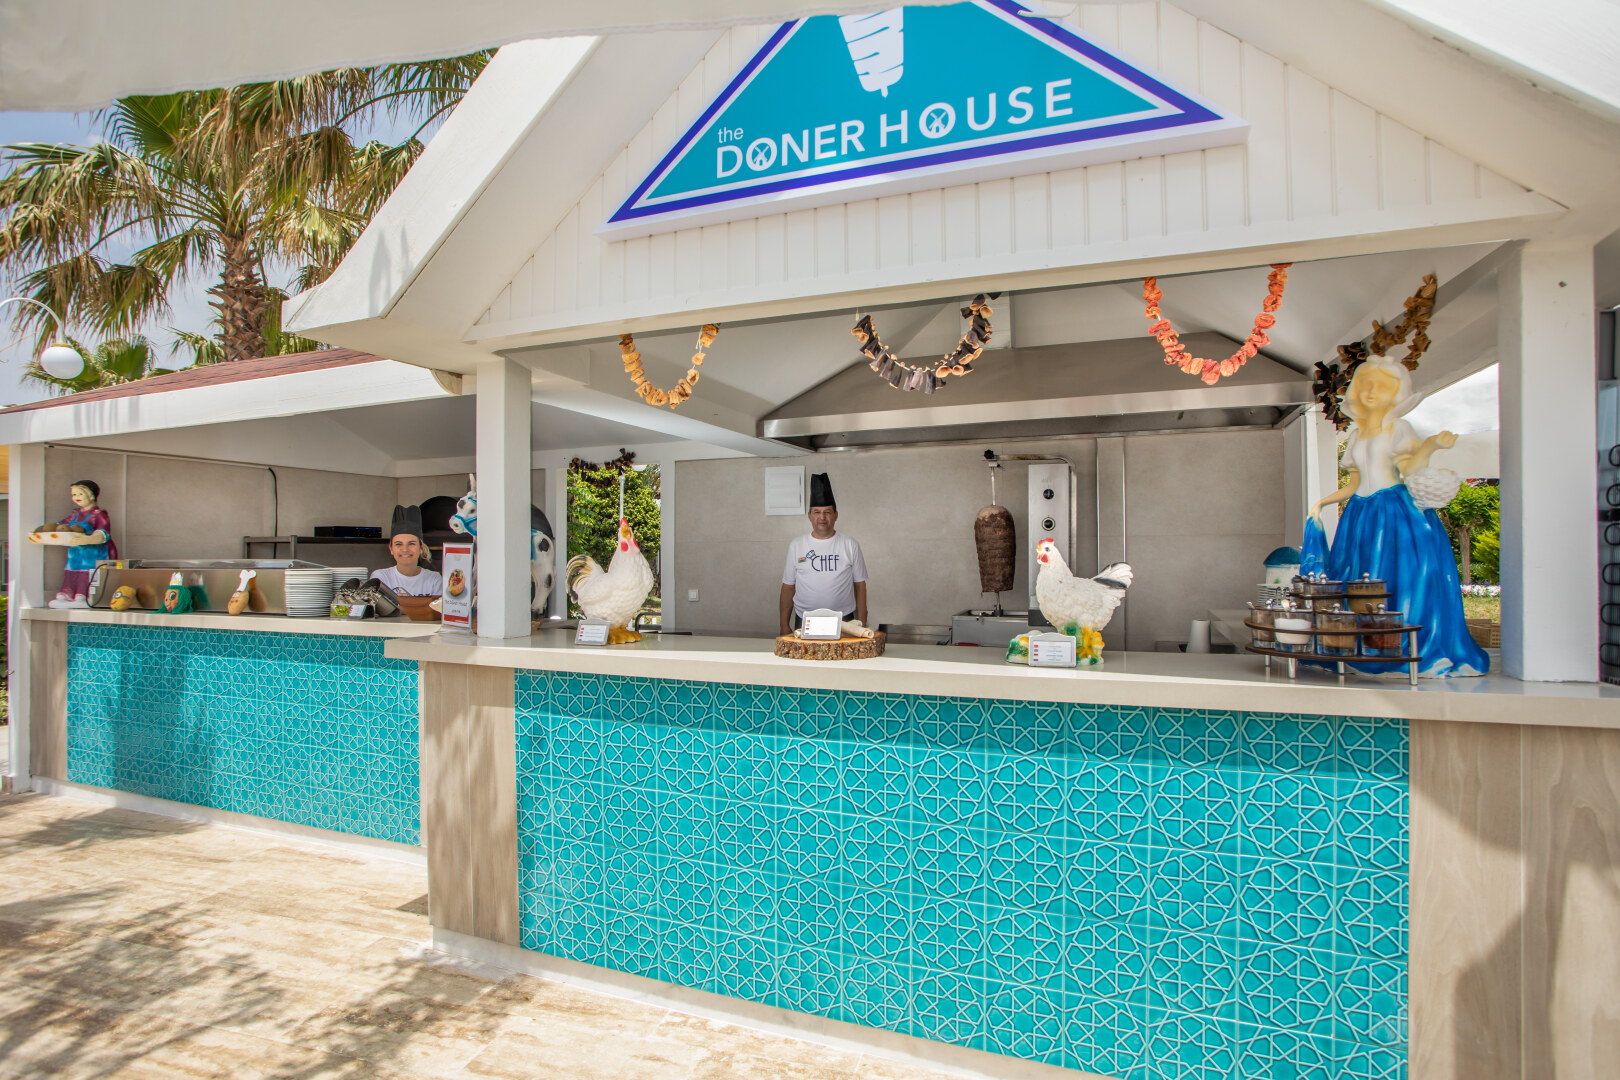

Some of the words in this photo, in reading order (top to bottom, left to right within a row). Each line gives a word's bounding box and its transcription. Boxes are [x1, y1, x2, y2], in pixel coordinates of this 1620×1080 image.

[716, 119, 866, 179] DONER
[880, 78, 1074, 148] HOUSE
[717, 126, 744, 144] the
[811, 554, 840, 572] CHEF
